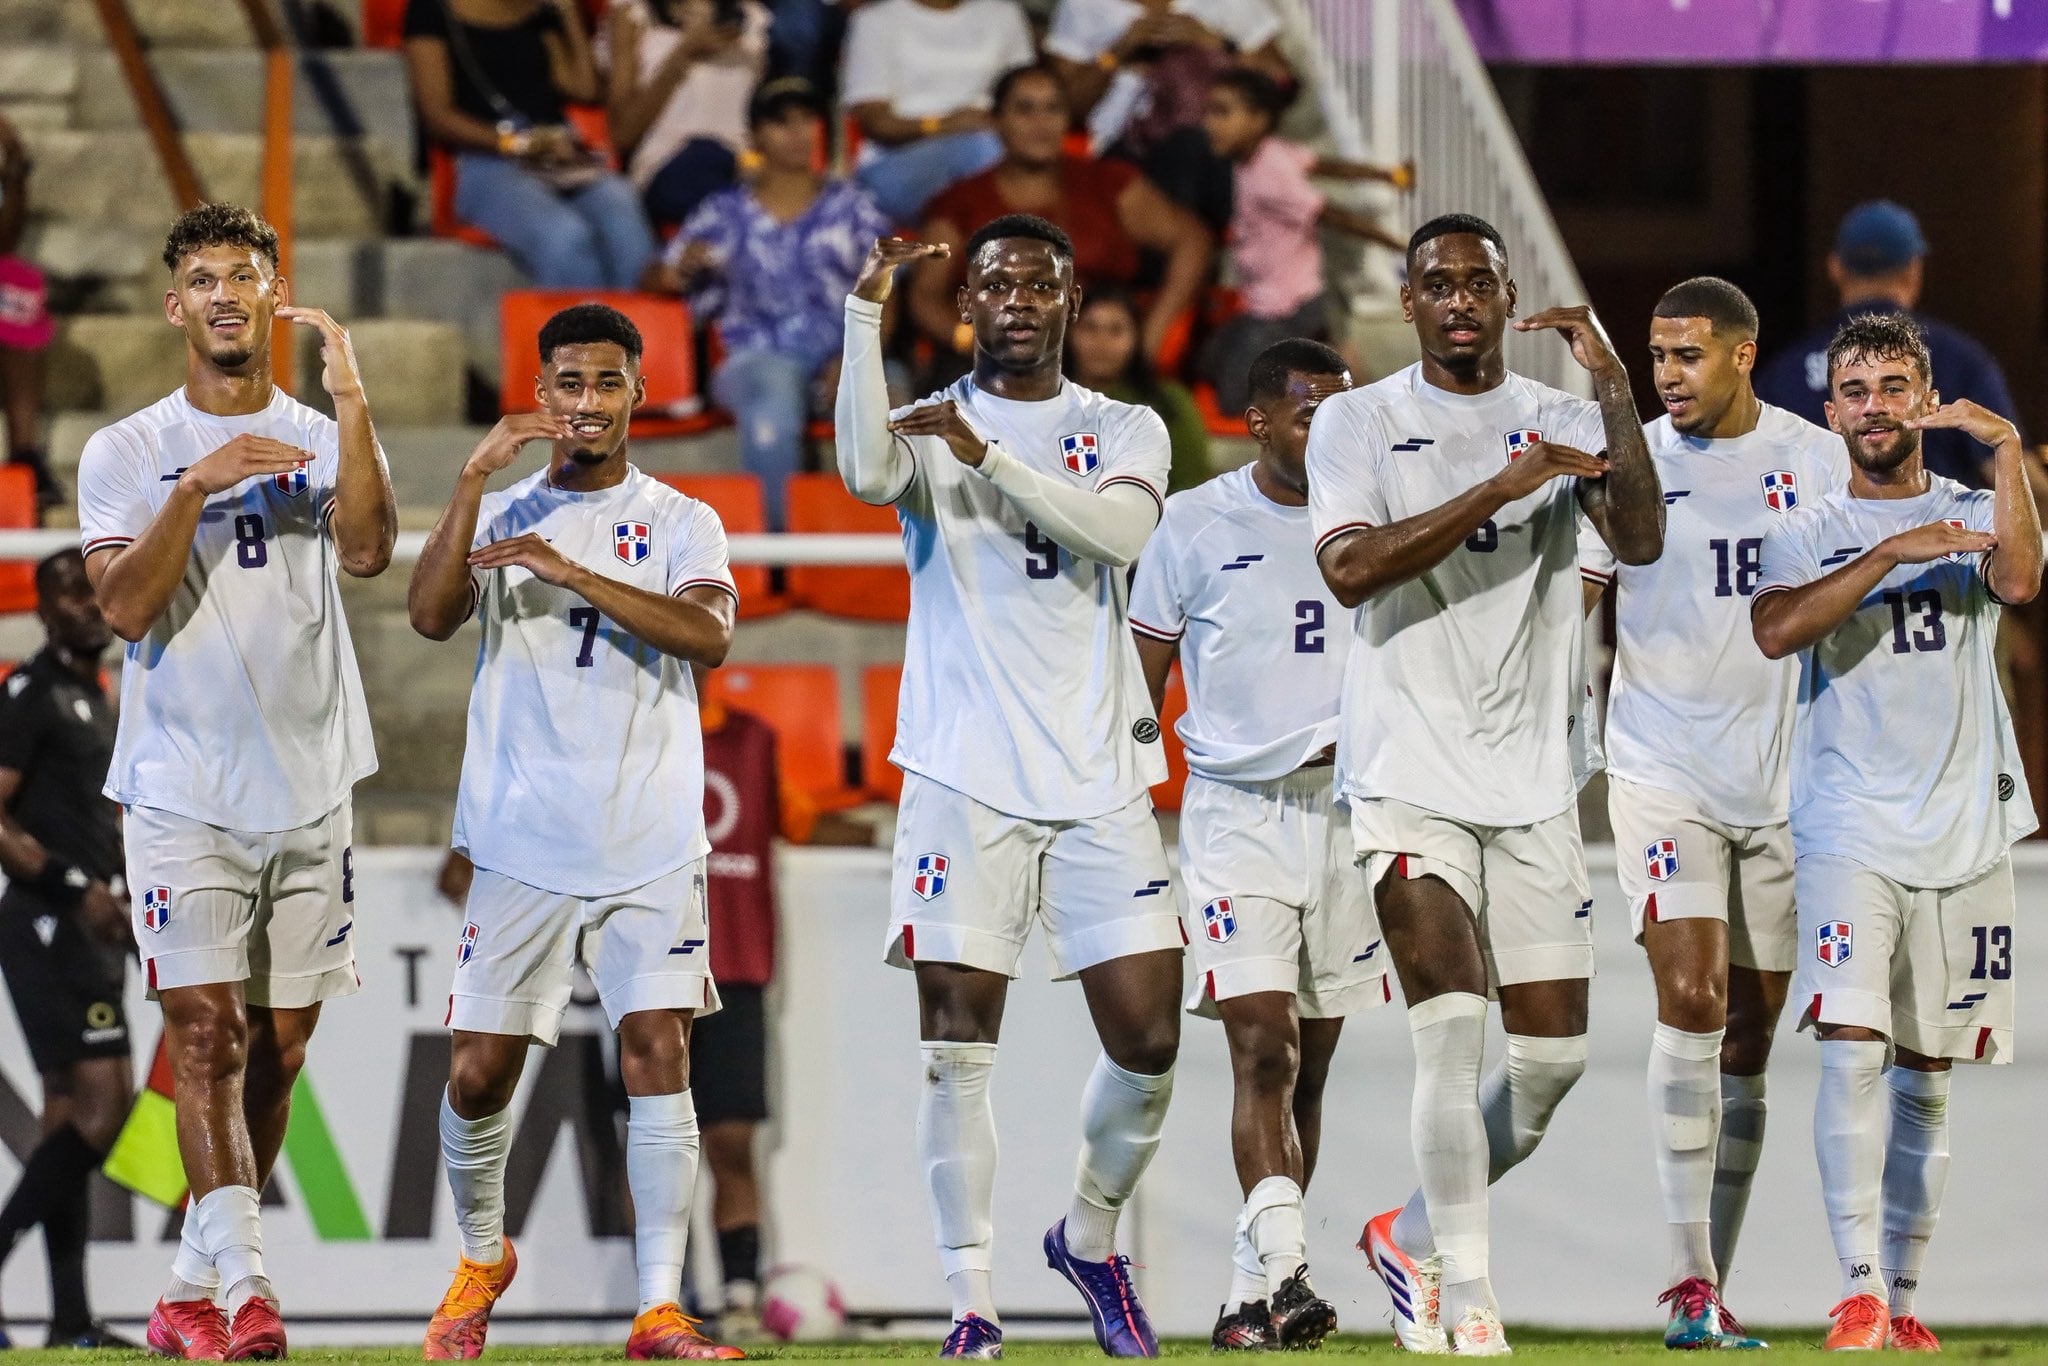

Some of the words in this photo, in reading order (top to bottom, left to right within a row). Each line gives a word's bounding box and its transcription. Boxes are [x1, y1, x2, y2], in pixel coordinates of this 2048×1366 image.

[1067, 446, 1094, 455] FDF
[1512, 442, 1529, 451] FD
[234, 513, 268, 569] 8
[619, 535, 645, 543] FDF
[1025, 521, 1059, 580] 9
[1709, 538, 1763, 597] 18
[1882, 588, 1947, 654] 13
[1295, 600, 1325, 654] 2
[569, 607, 600, 668] 7
[1650, 852, 1672, 863] FDF
[918, 869, 943, 877] FDF
[147, 902, 166, 910] FDF
[1209, 912, 1229, 923] FDF
[1821, 935, 1847, 944] FDF
[1970, 925, 2012, 980] 13
